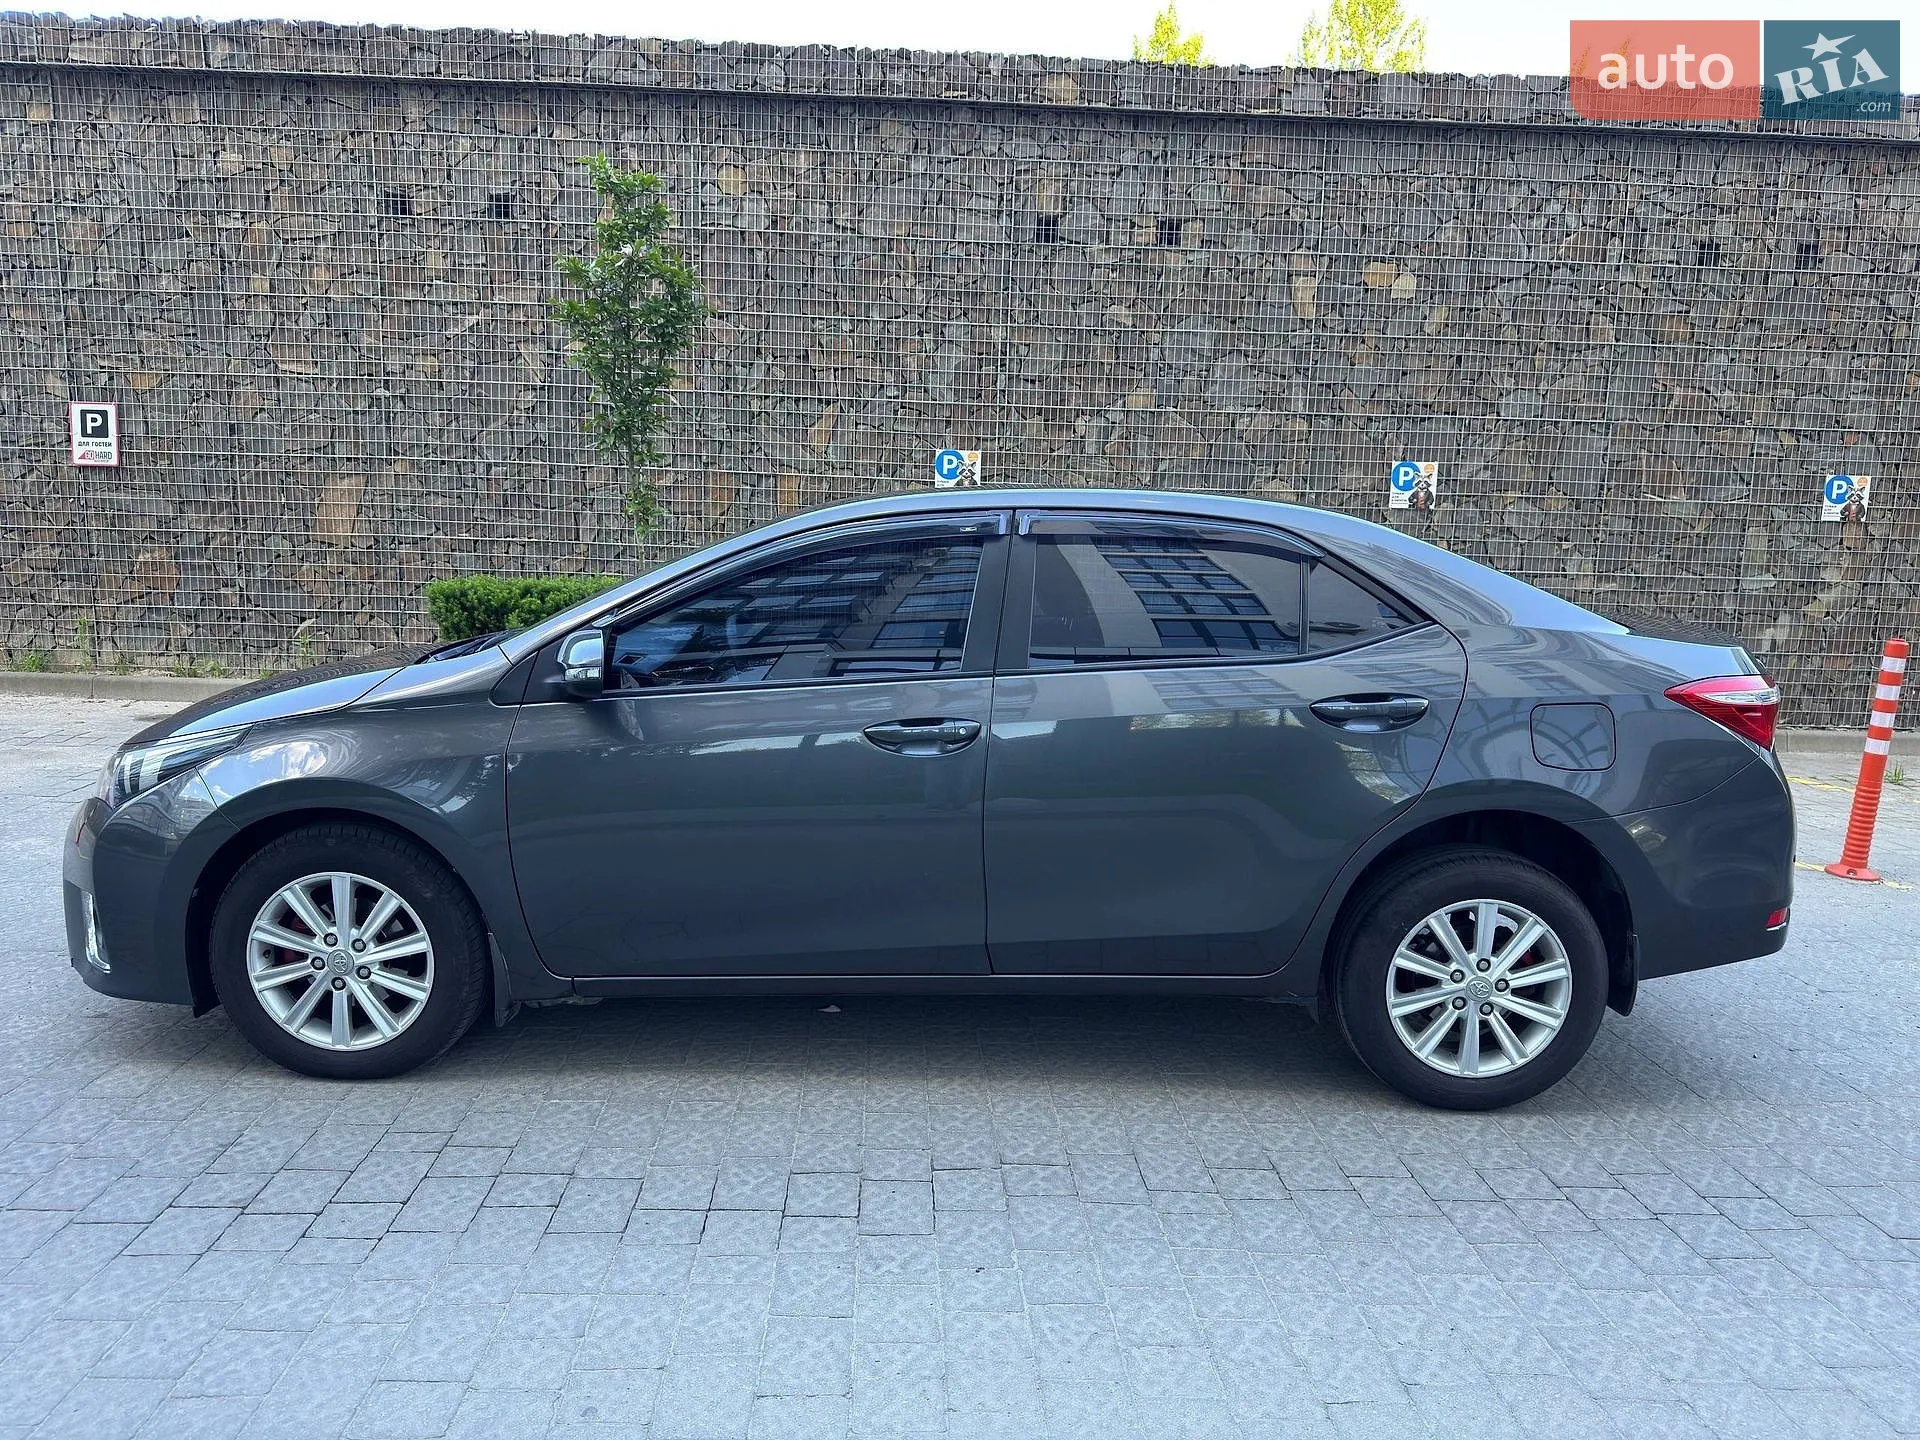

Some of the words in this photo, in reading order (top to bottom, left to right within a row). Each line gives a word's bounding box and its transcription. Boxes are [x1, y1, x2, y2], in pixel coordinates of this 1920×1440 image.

[86, 413, 103, 435] P
[943, 454, 958, 475] P
[1398, 466, 1414, 487] P
[1831, 480, 1847, 500] P
